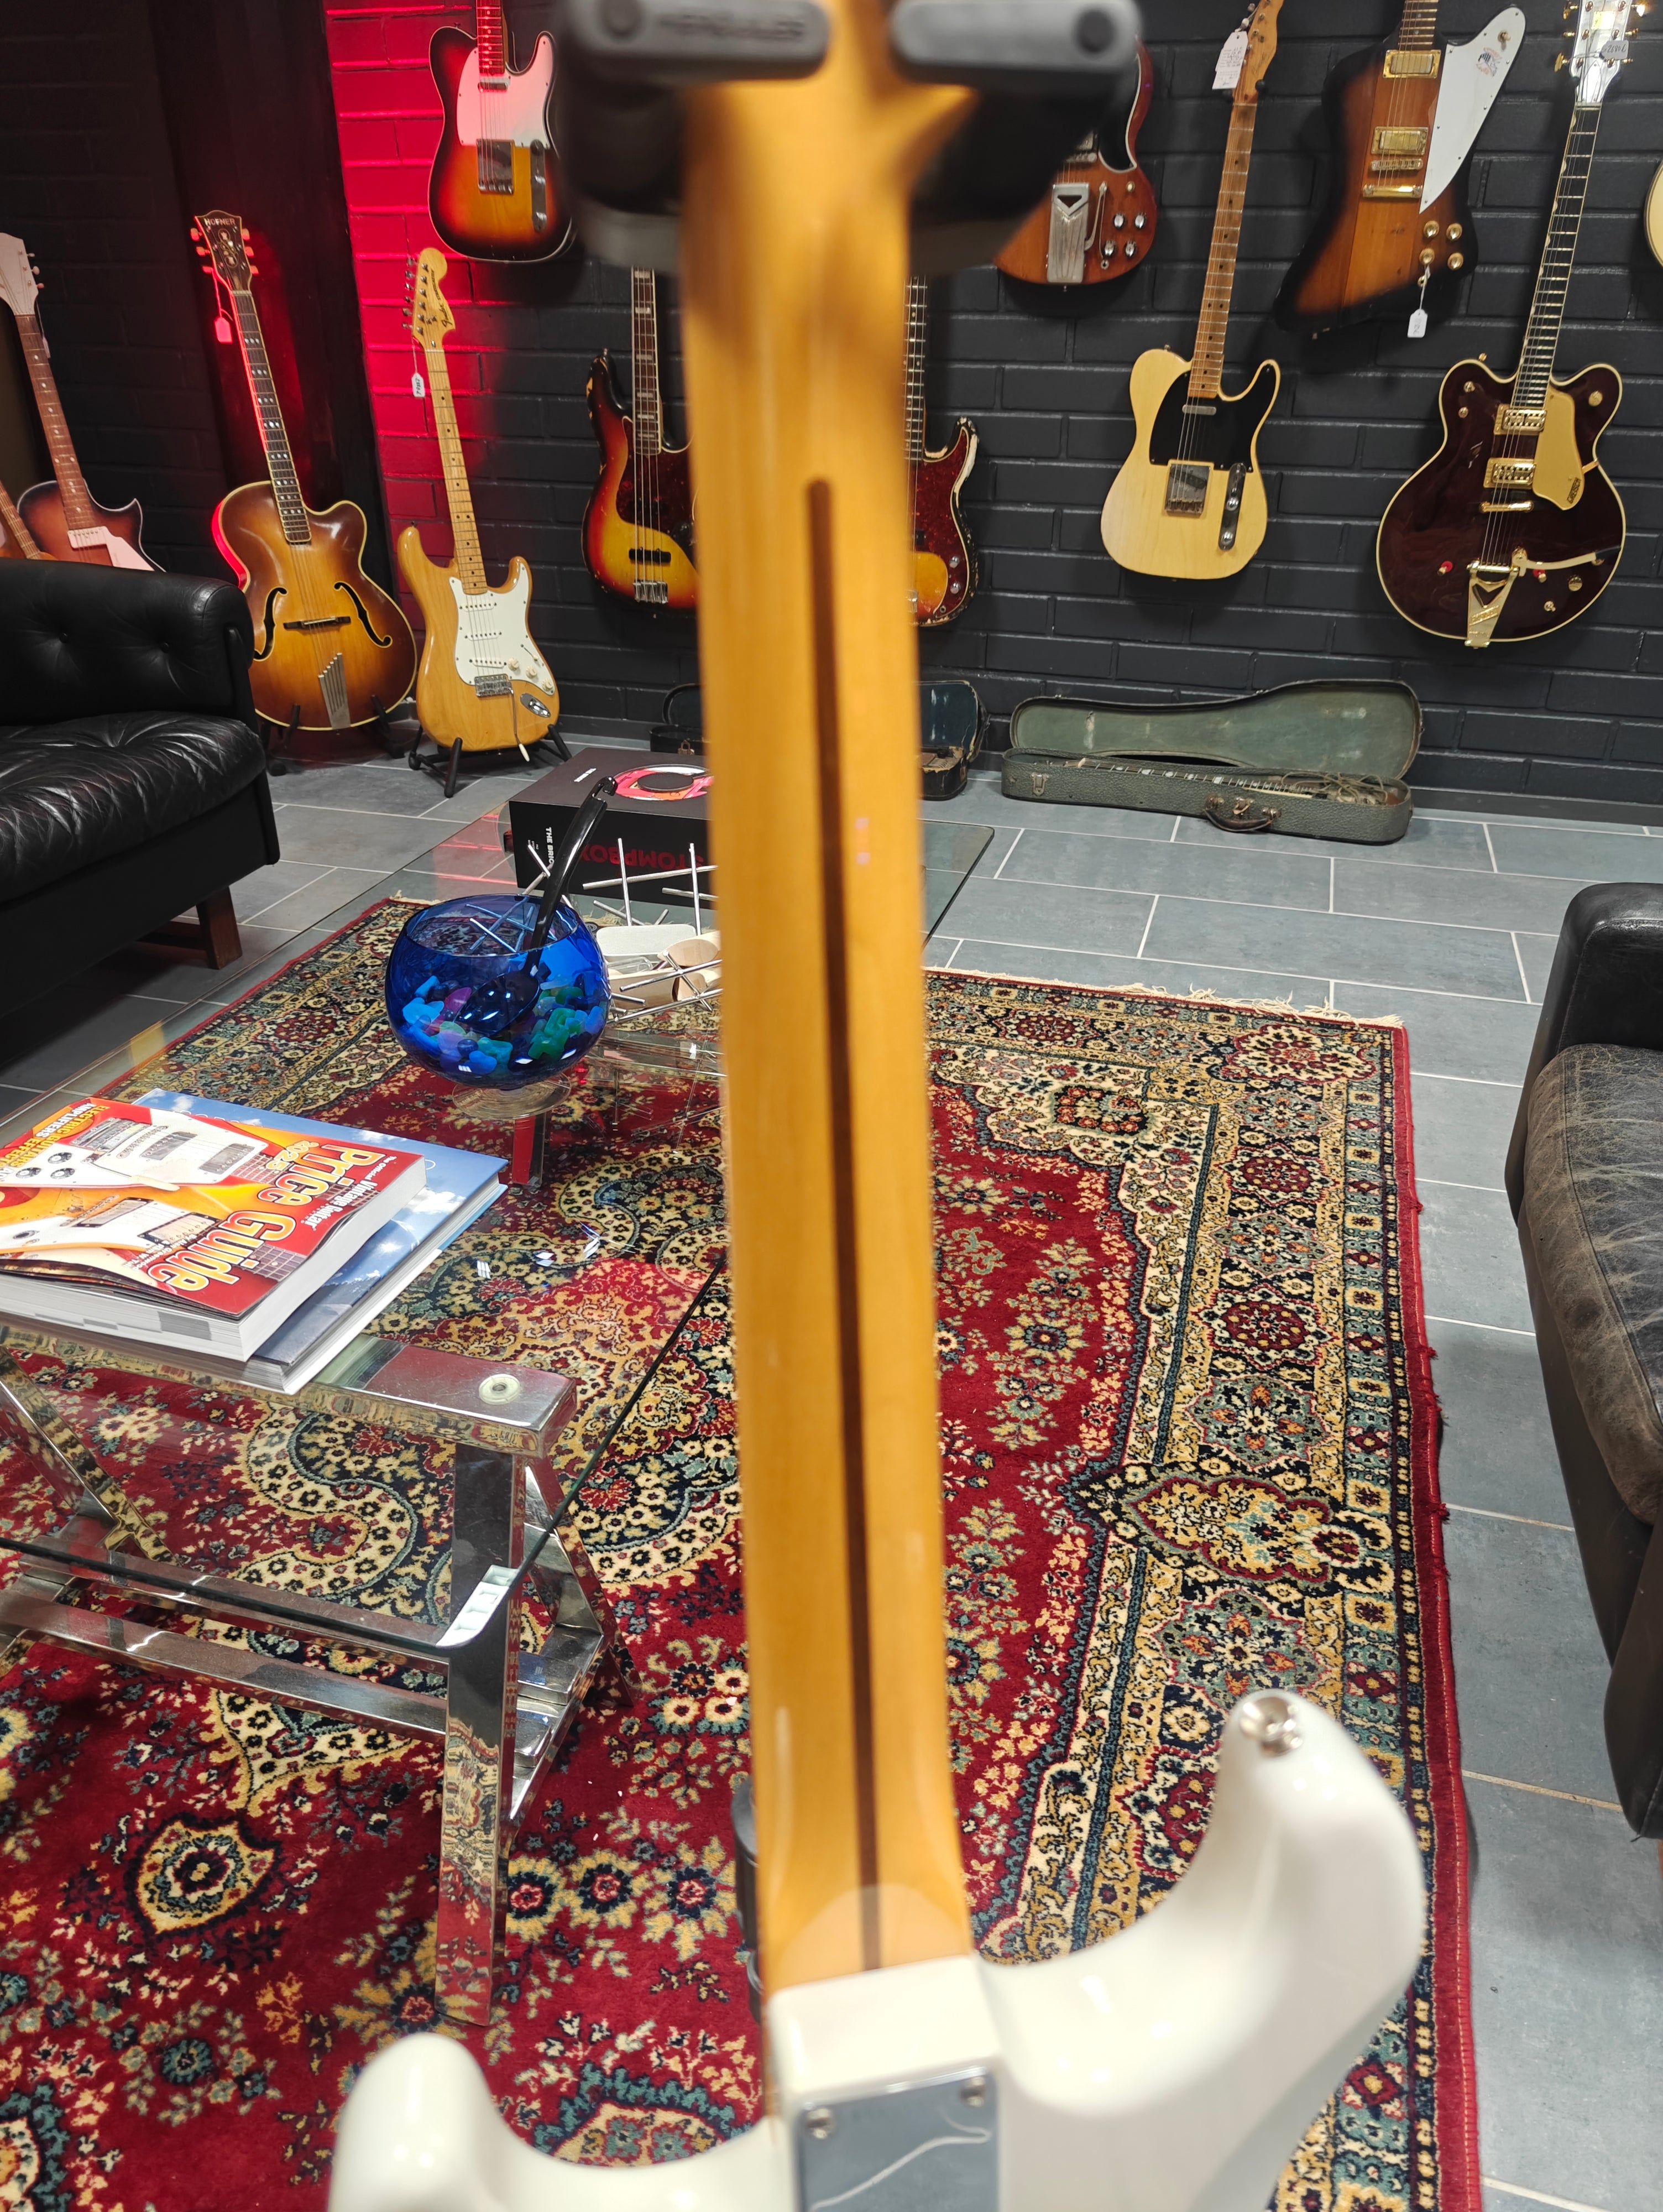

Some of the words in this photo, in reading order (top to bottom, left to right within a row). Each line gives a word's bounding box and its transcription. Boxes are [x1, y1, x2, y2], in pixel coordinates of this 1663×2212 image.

[36, 1103, 97, 1138] AMPLIFIERS
[57, 1105, 109, 1134] ELECTRIC
[10, 1135, 61, 1167] GUITARS
[265, 1140, 319, 1171] 2025
[257, 1144, 386, 1206] Price
[365, 1162, 387, 1181] Official
[333, 1180, 378, 1207] Vintage
[304, 1205, 343, 1229] Guitar
[132, 1247, 172, 1271] Greenwood
[148, 1210, 296, 1291] Guide
